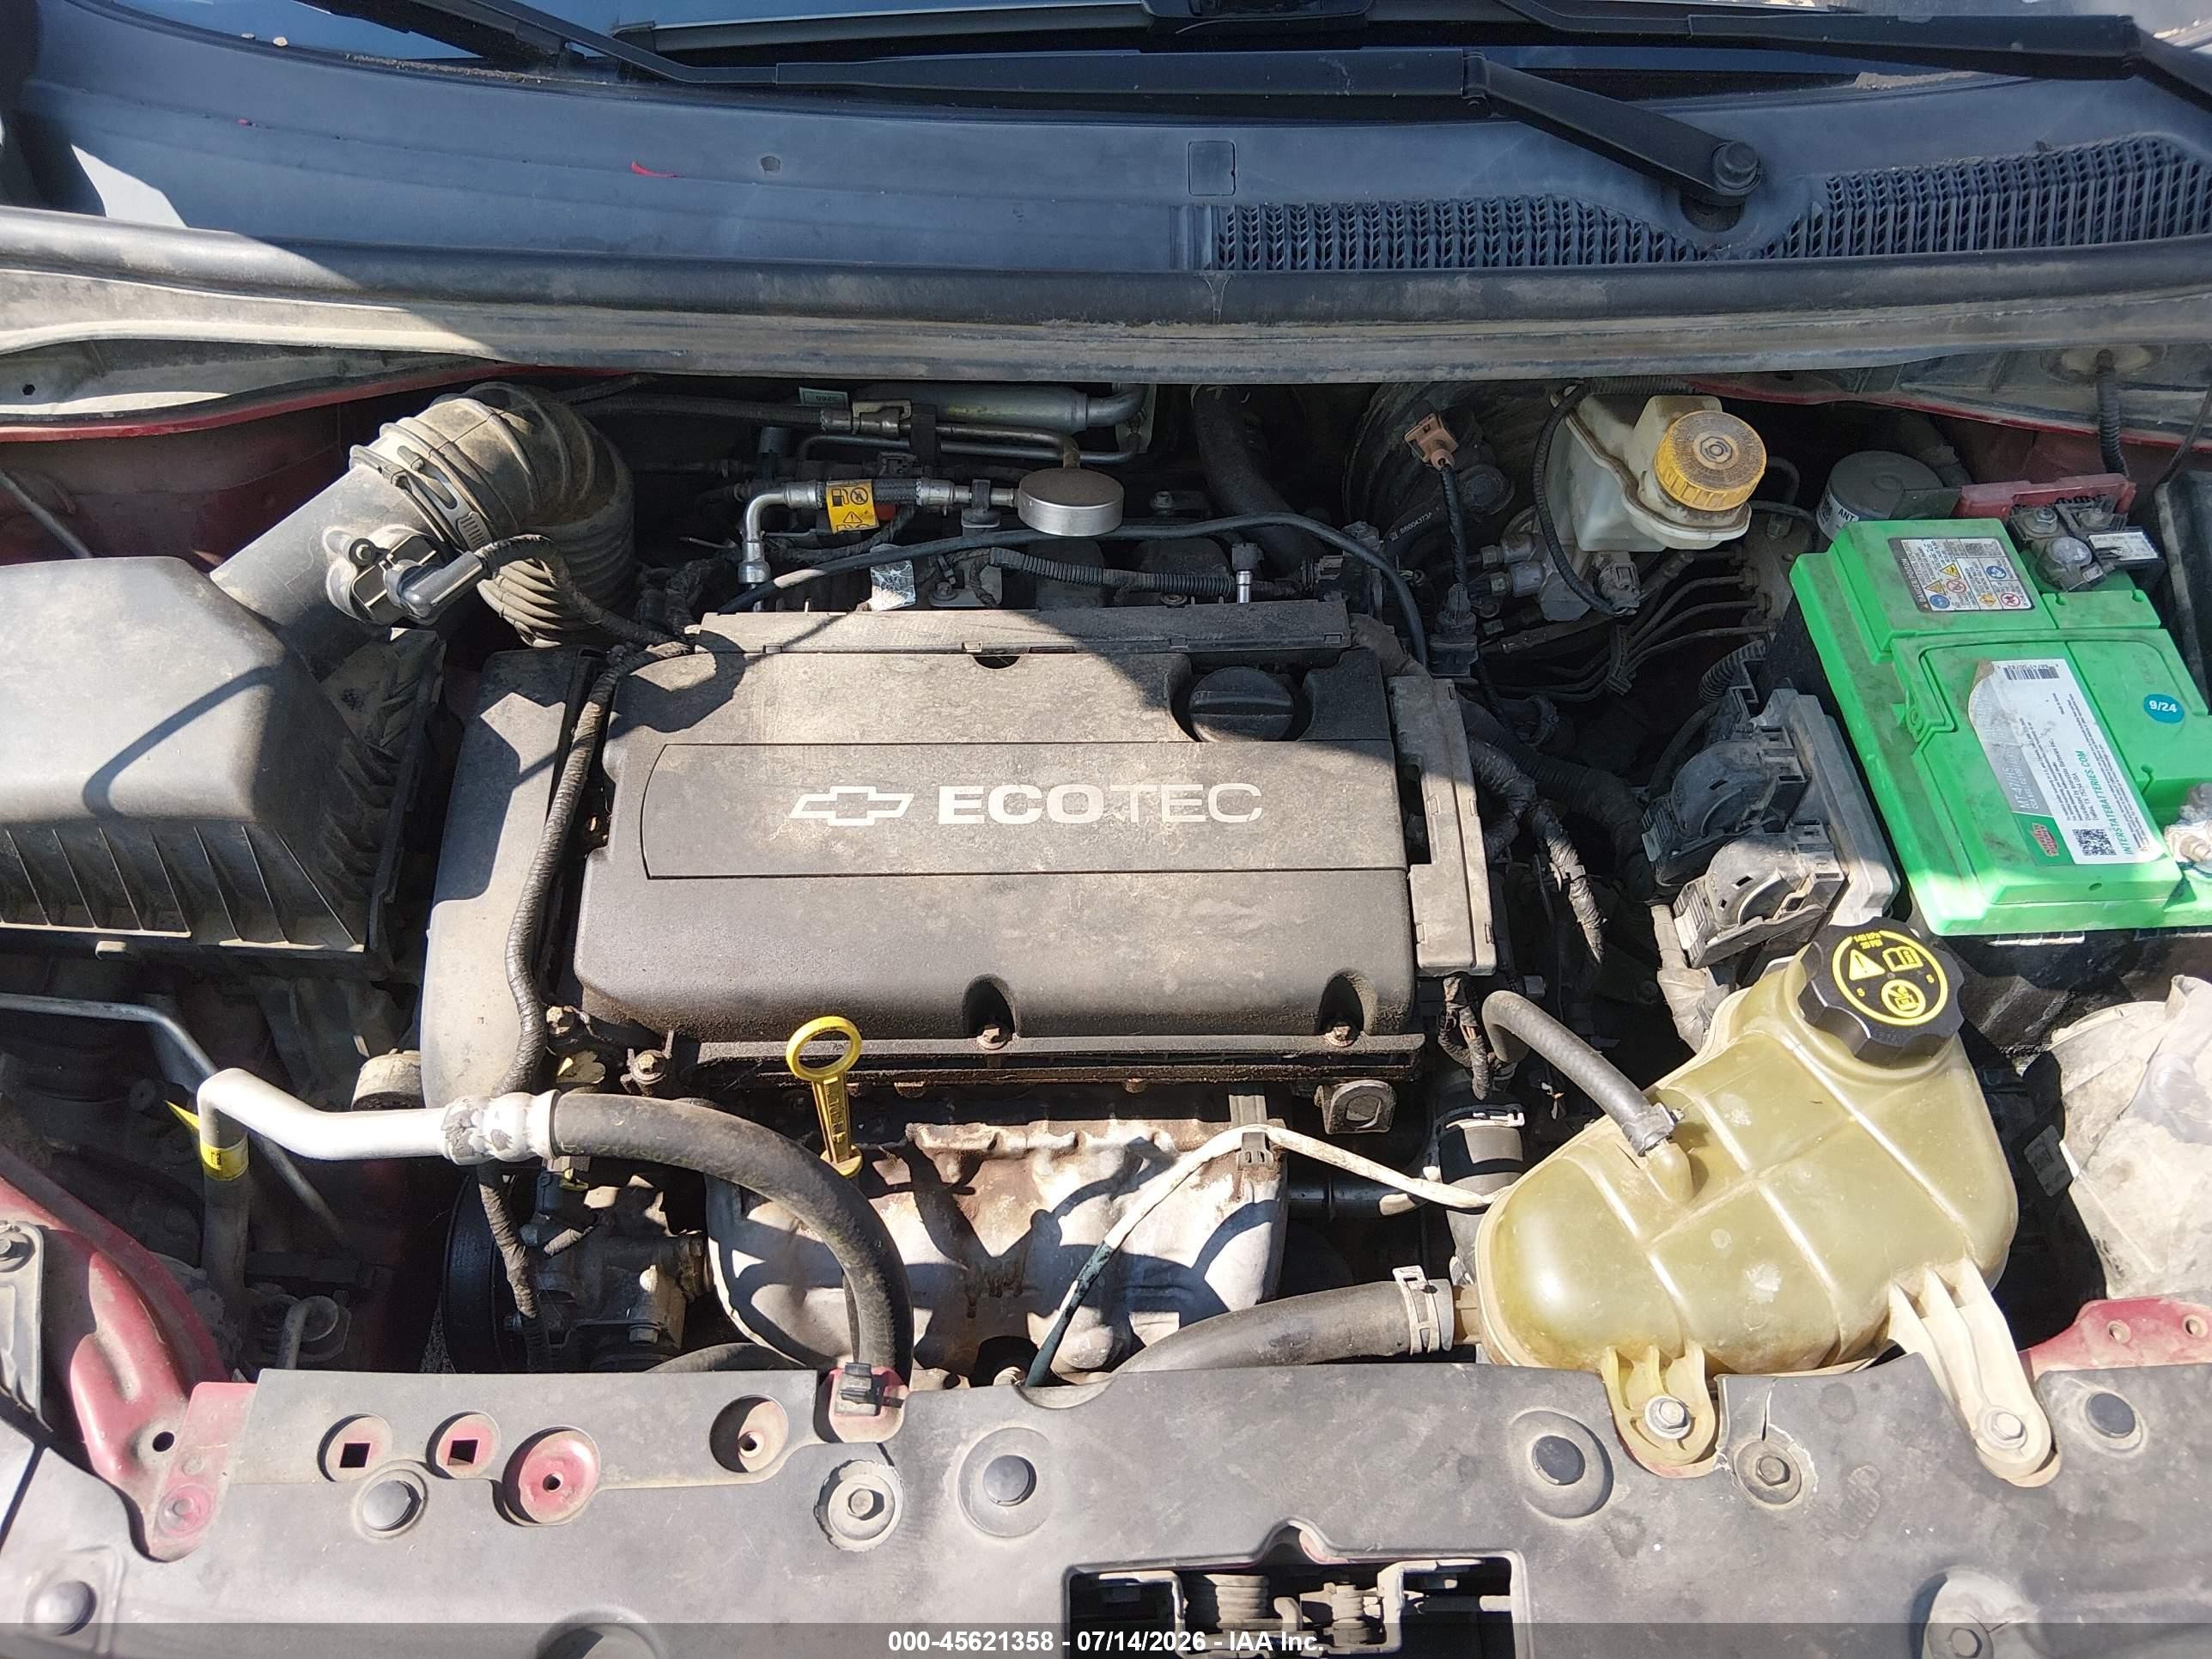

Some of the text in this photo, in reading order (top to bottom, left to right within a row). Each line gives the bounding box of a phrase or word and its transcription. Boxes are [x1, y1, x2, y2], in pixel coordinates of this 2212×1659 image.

[1838, 508, 1856, 522] ANT
[2148, 700, 2178, 713] 9/24
[938, 782, 1263, 824] ECOTEC
[2074, 750, 2134, 854] INTERSTATEBATTERIES.COM
